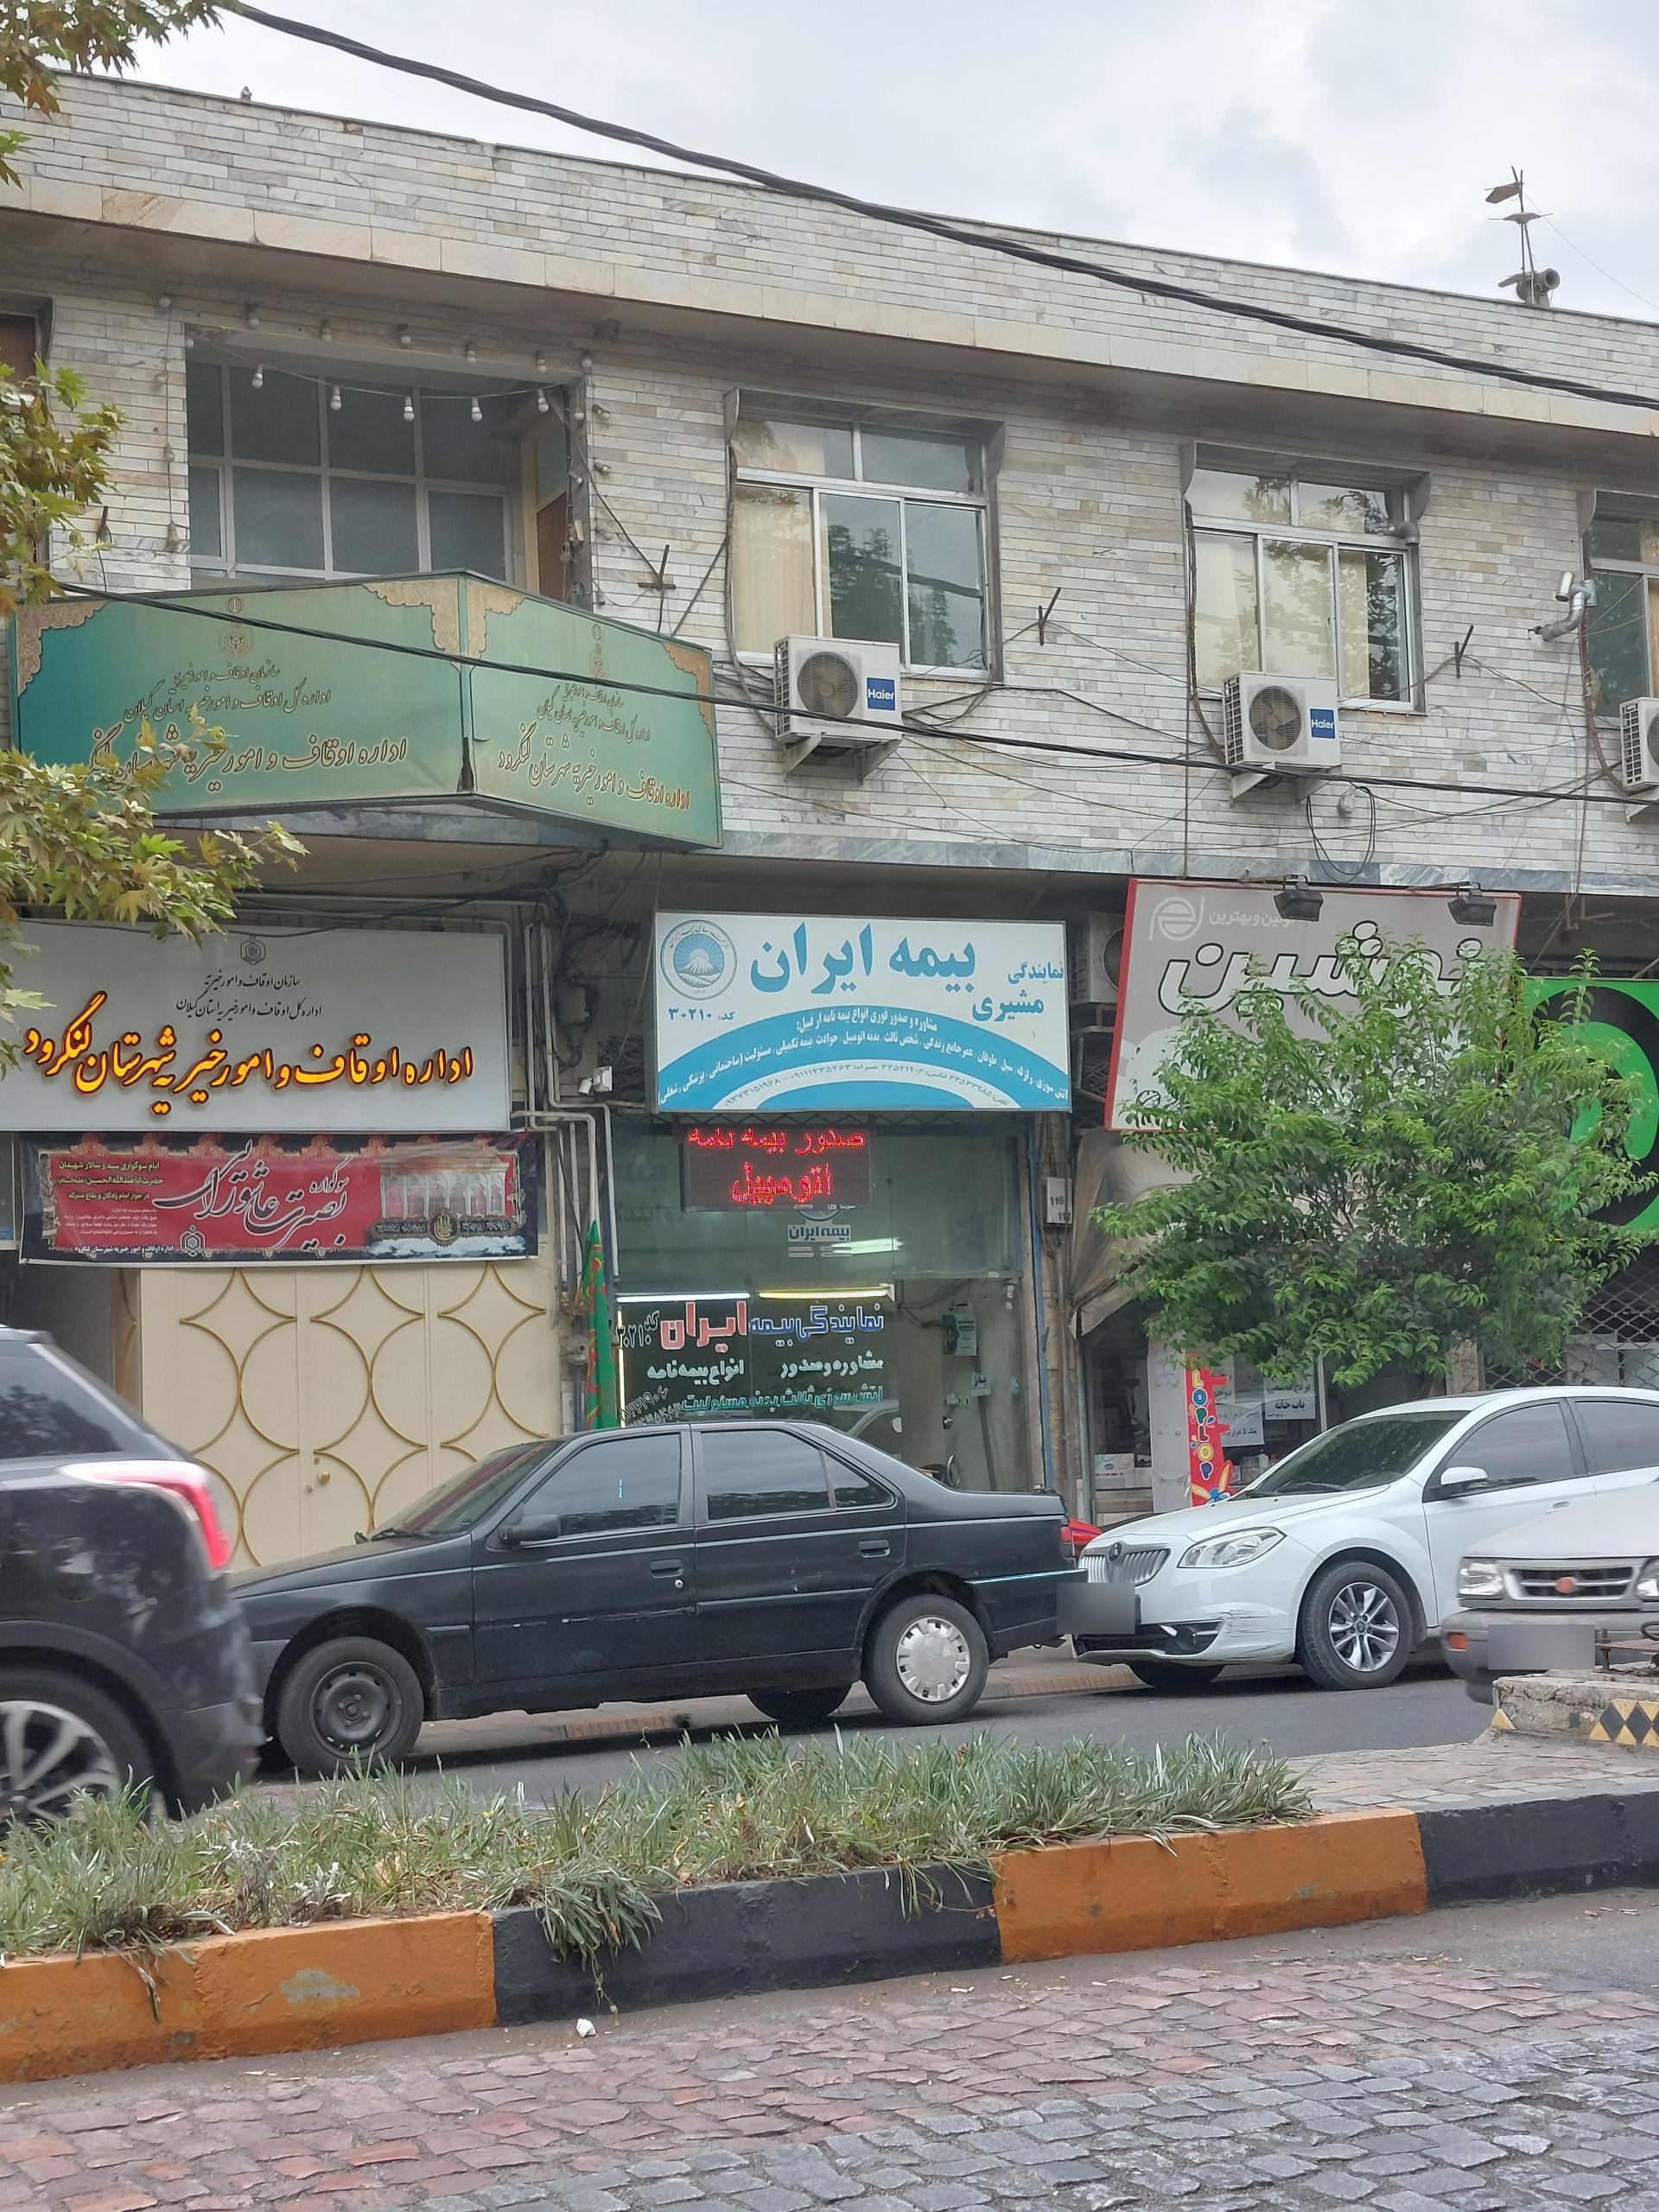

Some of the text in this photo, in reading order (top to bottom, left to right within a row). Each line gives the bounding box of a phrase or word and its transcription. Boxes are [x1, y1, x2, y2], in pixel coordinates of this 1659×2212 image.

[216, 662, 249, 681] اوقاف
[251, 659, 280, 685] سازمان
[207, 695, 231, 711] امور
[239, 684, 283, 709] اوقاف
[283, 677, 307, 714] کل
[303, 689, 331, 706] اداره
[868, 688, 895, 702] Haier
[1311, 717, 1335, 731] Haier
[222, 734, 408, 773] اداره اوقاف و امور
[528, 732, 572, 788] شهرستان
[594, 772, 616, 793] امور
[618, 779, 625, 796] و
[626, 769, 664, 804] اوقاف
[664, 787, 690, 810] اداره
[1210, 911, 1250, 926] بهترین
[750, 921, 977, 995] بیمه ایران
[221, 974, 238, 988] امور
[242, 972, 274, 988] اوقاف
[1007, 961, 1065, 985] نمایندگی
[273, 974, 301, 990] سازمان
[195, 998, 219, 1017] استان
[235, 1003, 251, 1016] امور
[257, 1001, 289, 1017] اوقاف
[289, 997, 306, 1020] کل
[302, 1005, 322, 1017] اداره
[971, 988, 1045, 1022] مشیری
[668, 1007, 713, 1021] ۳۰۲۱۰
[823, 1010, 836, 1023] نامه
[837, 1009, 850, 1021] بیمه
[851, 1007, 868, 1024] انواع
[869, 1007, 888, 1023] فوری
[889, 1010, 908, 1026] صدور
[914, 1016, 938, 1032] مشاوره
[799, 1038, 813, 1050] بیمه
[816, 1032, 838, 1047] حوادث
[842, 1030, 865, 1046] اتومبیل
[883, 1031, 899, 1044] ثالث
[899, 1033, 919, 1047] شخص
[923, 1037, 945, 1053] زندگی
[23, 989, 475, 1116] اداره اوقاف و امور خیریه شهرستان لنگرود
[744, 1046, 772, 1063] مسئولیت
[775, 1037, 798, 1056] تکمیلی
[977, 1050, 997, 1067] طوفان
[1000, 1058, 1014, 1073] سیل
[1035, 1077, 1054, 1094] سوزی
[741, 1128, 786, 1154] بیمه
[794, 1128, 864, 1154] صدور
[59, 1160, 85, 1171] شهیدان
[85, 1161, 101, 1171] سالار
[120, 1160, 148, 1171] سوگواری
[149, 1161, 160, 1173] ایام
[309, 1154, 354, 1193] سوگواره
[143, 1177, 164, 1186] حضرت
[732, 1161, 832, 1205] اتومبیل
[244, 1189, 347, 1252] بصیرت
[789, 1225, 850, 1241] بیمه ایران
[660, 1300, 747, 1354] ایران
[795, 1302, 884, 1342] نمایندگی
[748, 1318, 796, 1347] بیمه
[647, 1358, 744, 1385] انواع بیمه نامه
[780, 1358, 823, 1379] صدور
[832, 1350, 884, 1376] مشاوره
[779, 1385, 815, 1407] ثالث
[681, 1394, 748, 1416] مسئولیت
